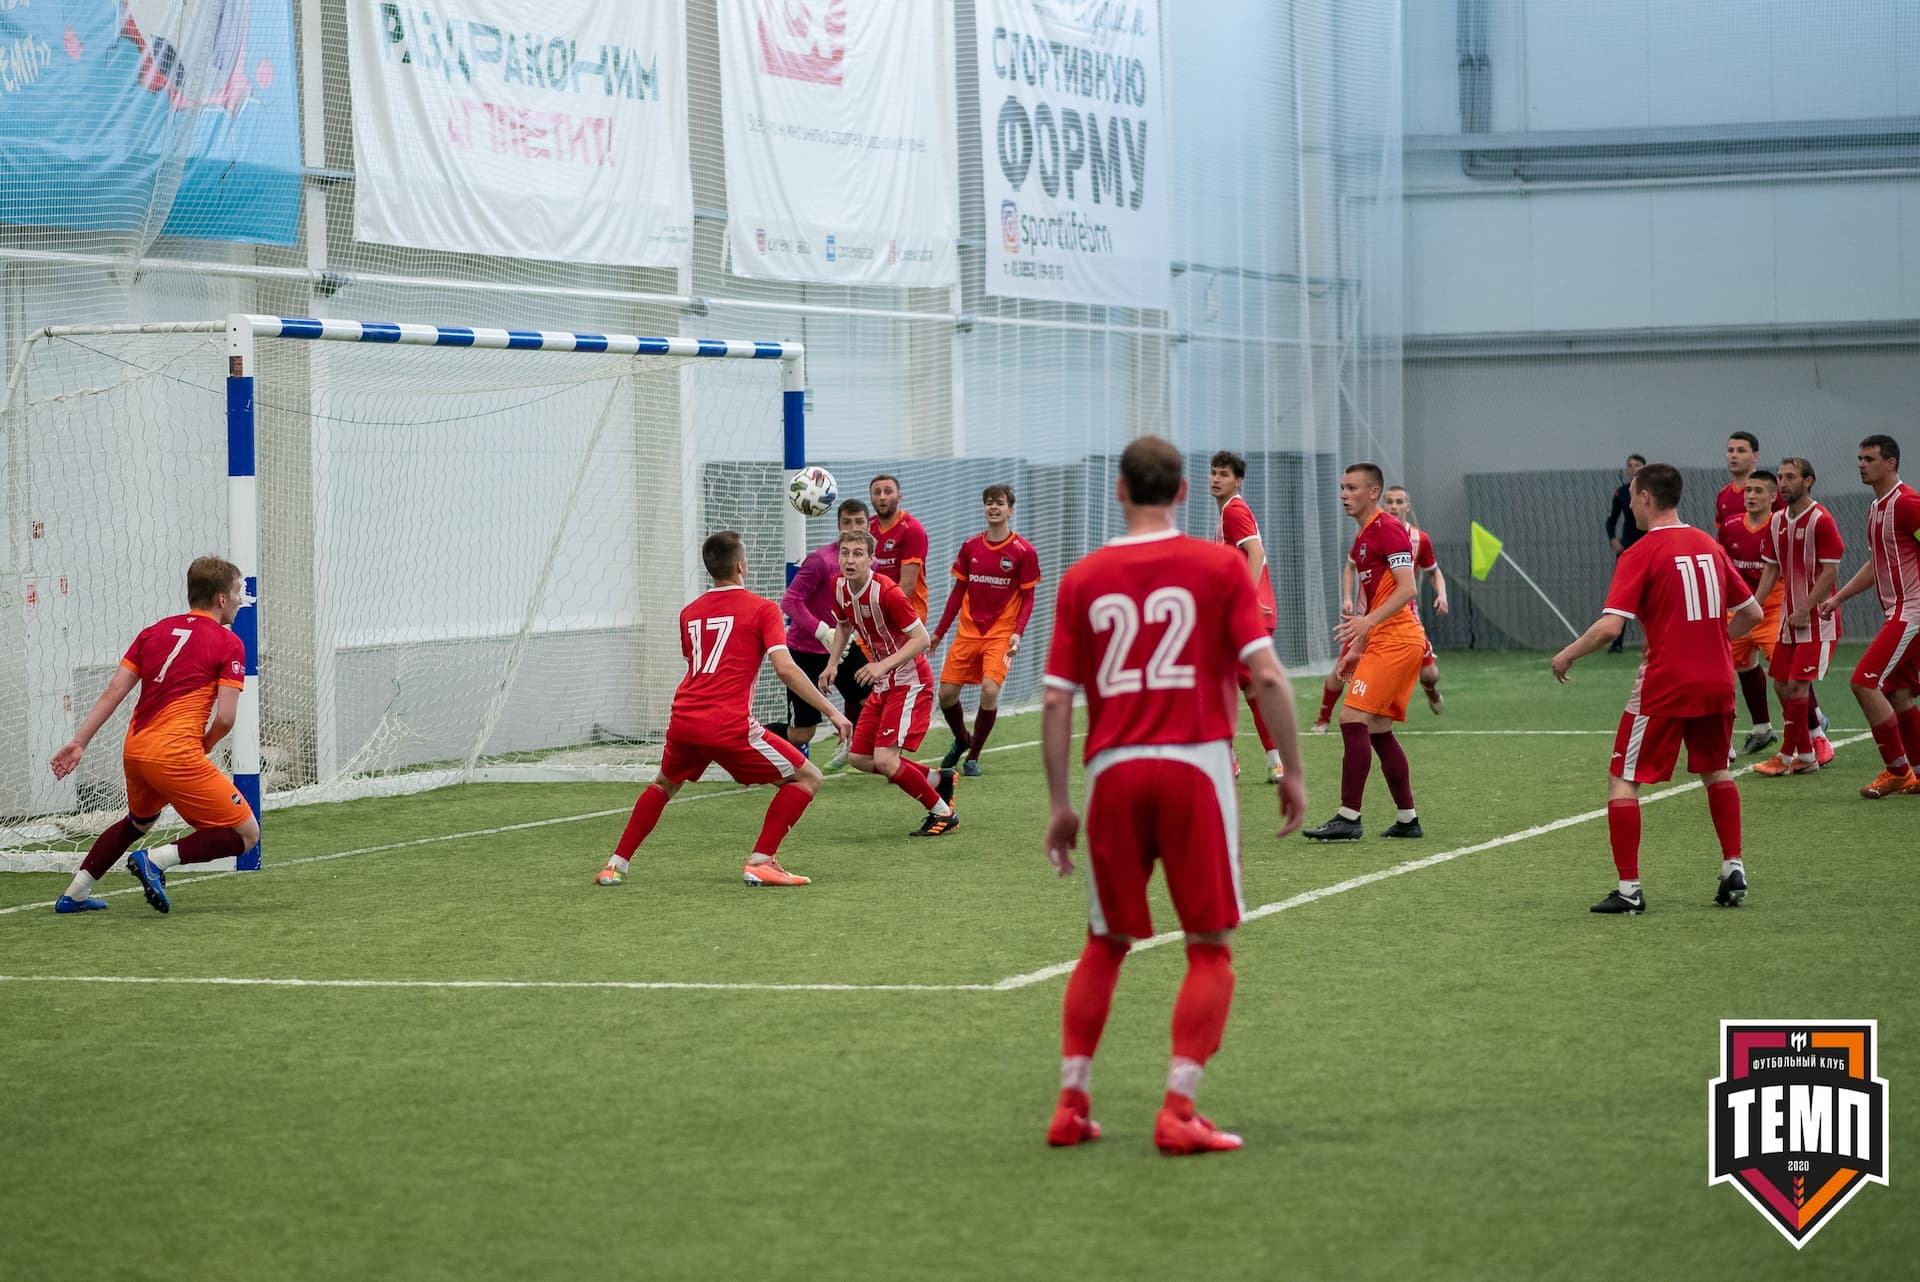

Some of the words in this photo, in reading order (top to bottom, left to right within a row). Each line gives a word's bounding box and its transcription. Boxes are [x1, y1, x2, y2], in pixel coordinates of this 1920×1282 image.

[380, 2, 660, 101] РАЗДРАКОНИМ
[993, 27, 1146, 107] СПОРТИВНУЮ
[997, 95, 1147, 211] ФОРМУ
[1674, 554, 1721, 622] 11
[153, 627, 193, 684] 7
[688, 615, 735, 678] 17
[1088, 586, 1197, 698] 22
[1352, 679, 1367, 697] 24
